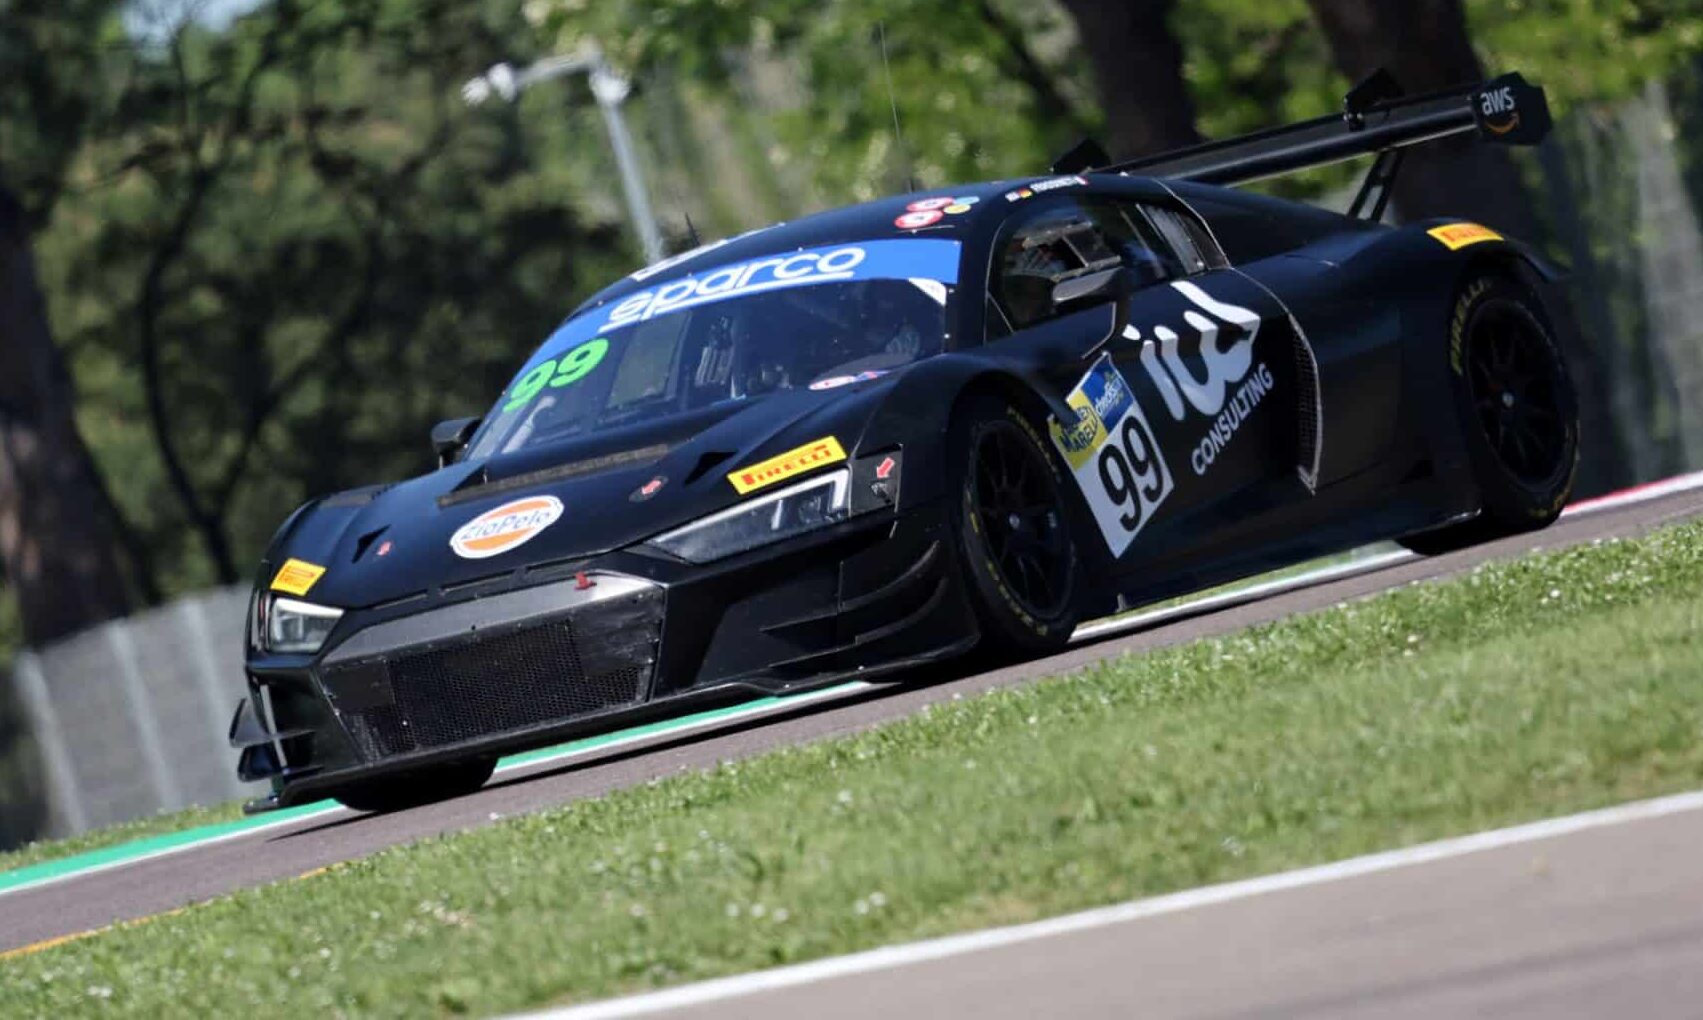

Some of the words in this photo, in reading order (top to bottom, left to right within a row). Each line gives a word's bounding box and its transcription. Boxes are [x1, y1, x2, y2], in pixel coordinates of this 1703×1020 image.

[1481, 86, 1515, 115] aws
[501, 338, 610, 413] 99
[1191, 363, 1273, 475] CONSULTING
[741, 444, 831, 486] PIRELLI
[1098, 415, 1164, 533] 99
